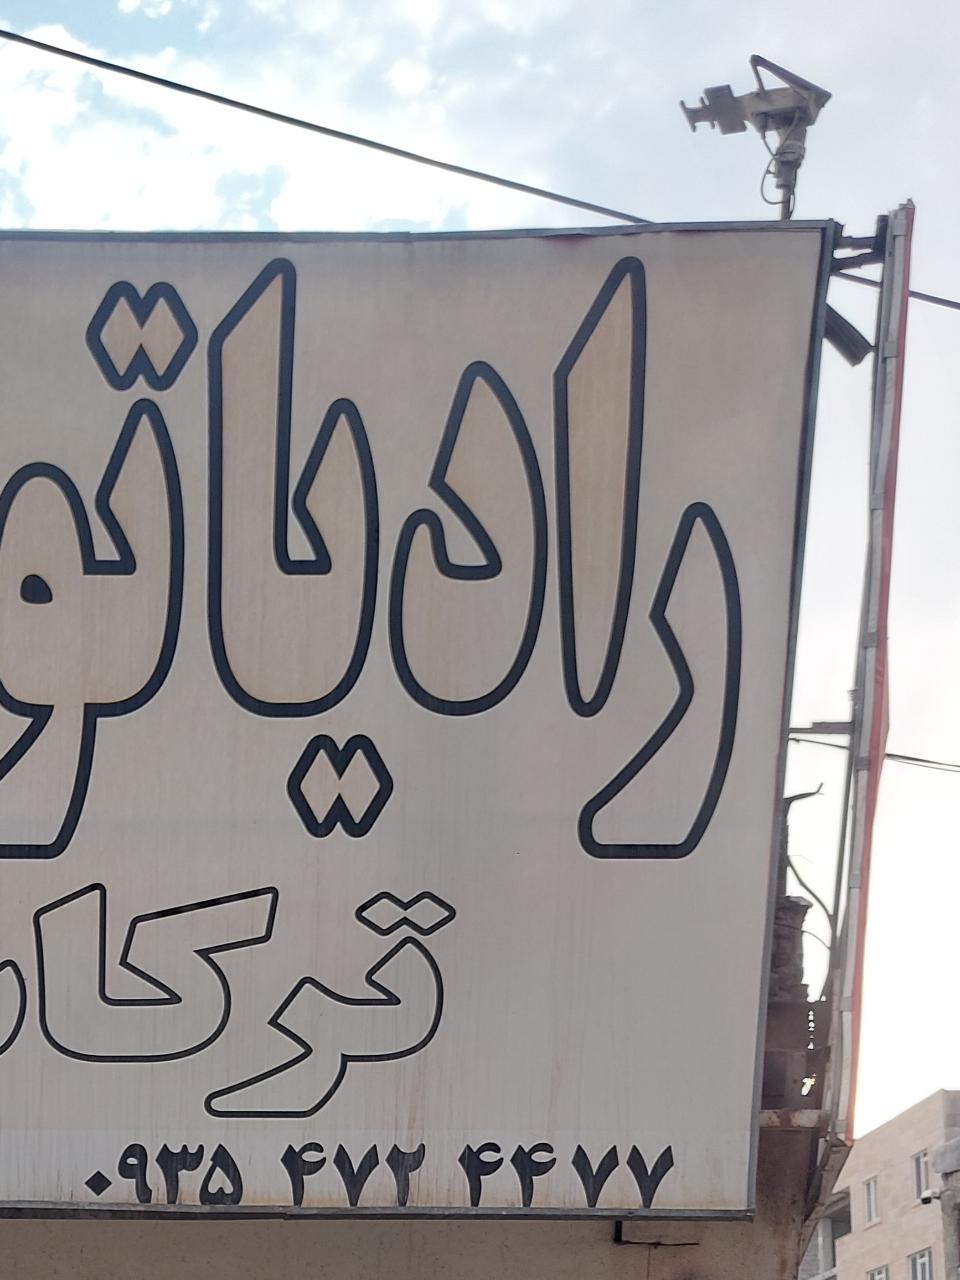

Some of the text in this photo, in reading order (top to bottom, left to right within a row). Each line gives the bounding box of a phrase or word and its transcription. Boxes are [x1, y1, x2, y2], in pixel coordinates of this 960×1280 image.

[83, 1140, 675, 1209] ۰۹۳۵ ۴۷۲ ۴۴۷۷
